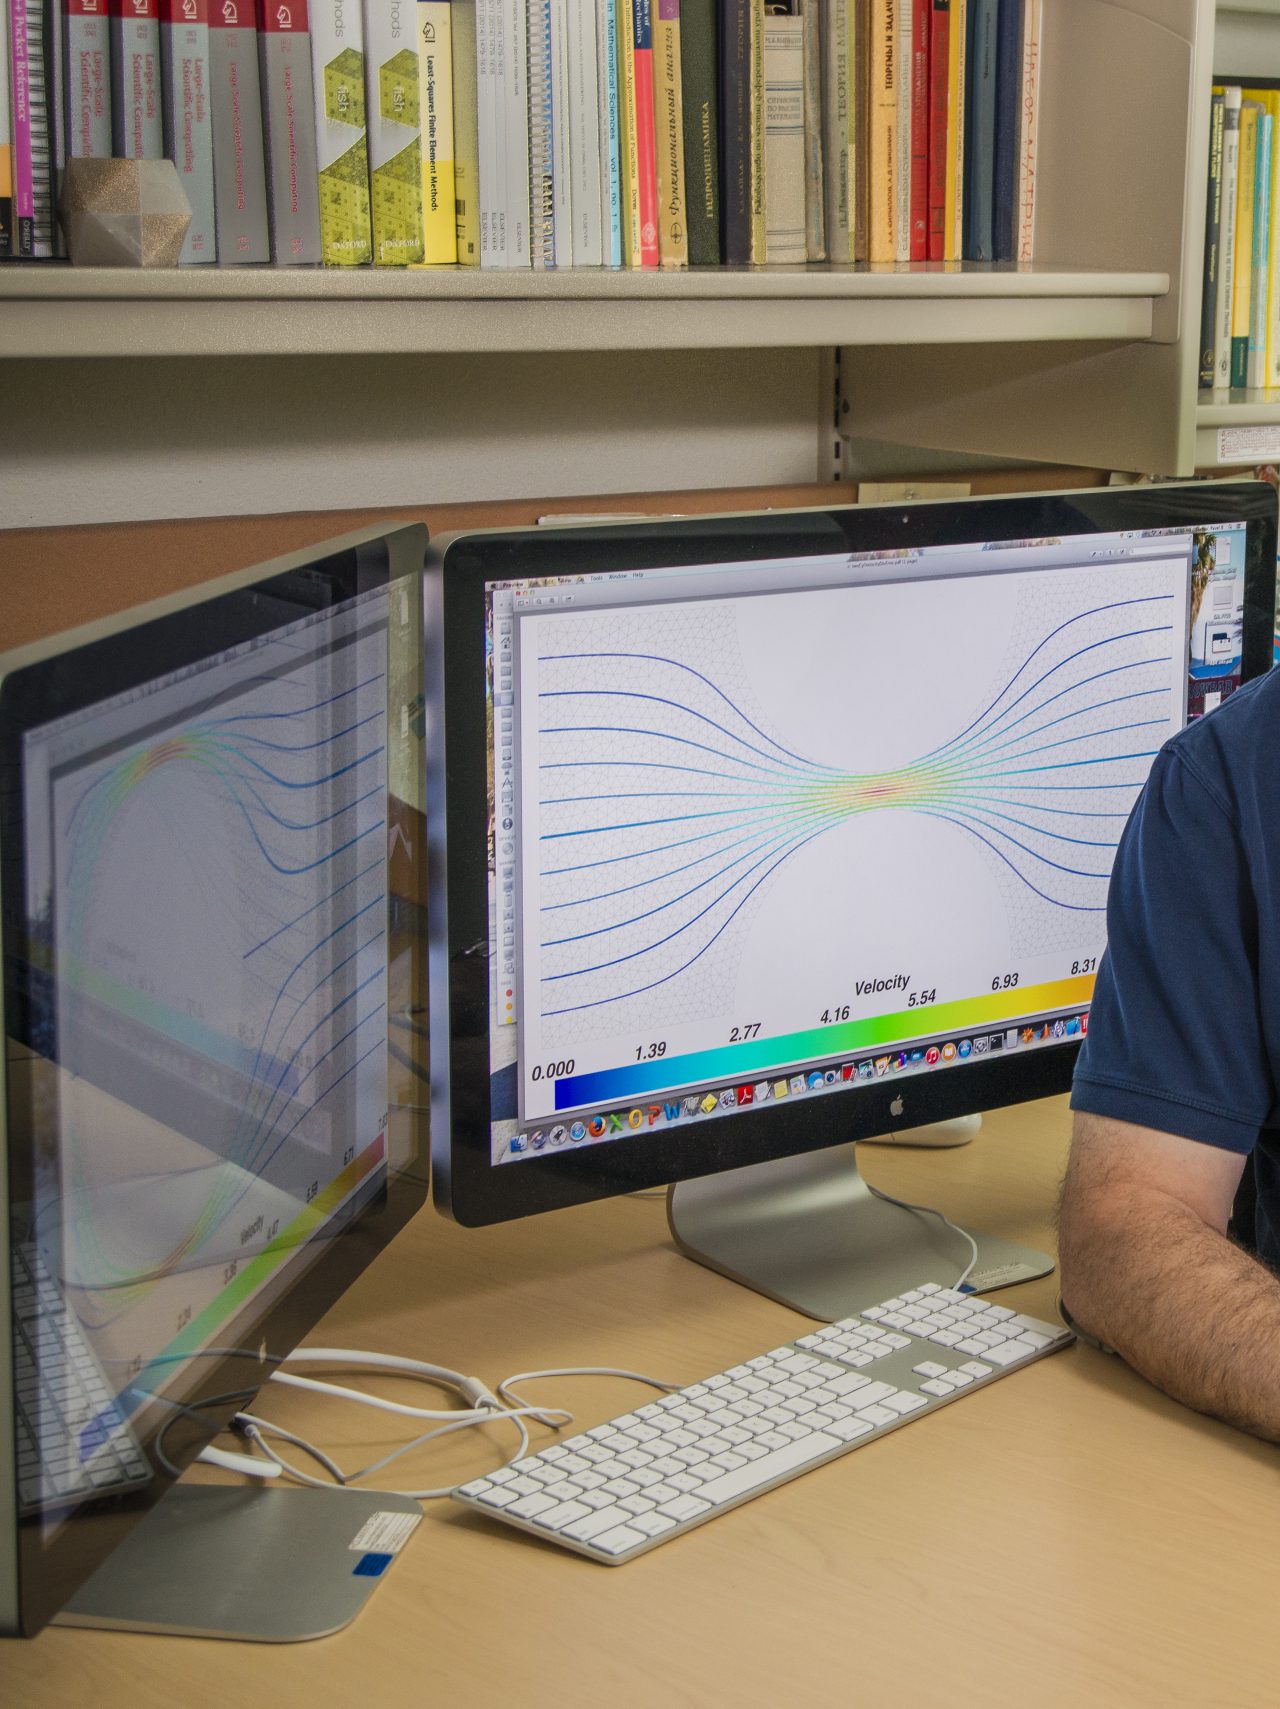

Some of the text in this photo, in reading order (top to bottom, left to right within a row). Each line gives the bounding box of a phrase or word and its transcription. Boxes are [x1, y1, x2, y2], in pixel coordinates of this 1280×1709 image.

[608, 3, 615, 12] in
[625, 6, 633, 53] Introduction
[644, 16, 651, 26] of
[15, 16, 28, 122] Pocket Reference
[607, 19, 616, 89] Mathematical
[627, 53, 633, 61] to
[885, 44, 894, 90] ТЕОРЕМЫ
[133, 53, 143, 105] Scientific
[837, 53, 847, 122] ТЕОРИЯ
[81, 51, 93, 159] Scientific Computin
[182, 58, 195, 173] Scientific Computing
[609, 93, 618, 140] Sciences
[627, 75, 636, 132] Approximation
[663, 27, 681, 216] Функциональный анализ
[426, 55, 440, 212] Least-Squares Finite Element Methods
[630, 133, 637, 141] of
[701, 101, 714, 219] ГИДРОДИНАМИКА
[235, 160, 245, 210] Computing
[290, 163, 300, 213] Computing
[481, 212, 489, 252] ELSEVIER
[490, 212, 498, 252] ELSEVIER
[502, 581, 524, 589] Preview
[608, 573, 627, 581] Window
[632, 571, 644, 580] Help
[855, 974, 911, 997] Velocity
[531, 957, 1097, 1082] 0.000 1.39 2.77 4.16 5.54 6.93 8.31
[648, 1104, 661, 1126] P
[663, 1102, 681, 1121] W
[240, 1214, 265, 1247] Velocity
